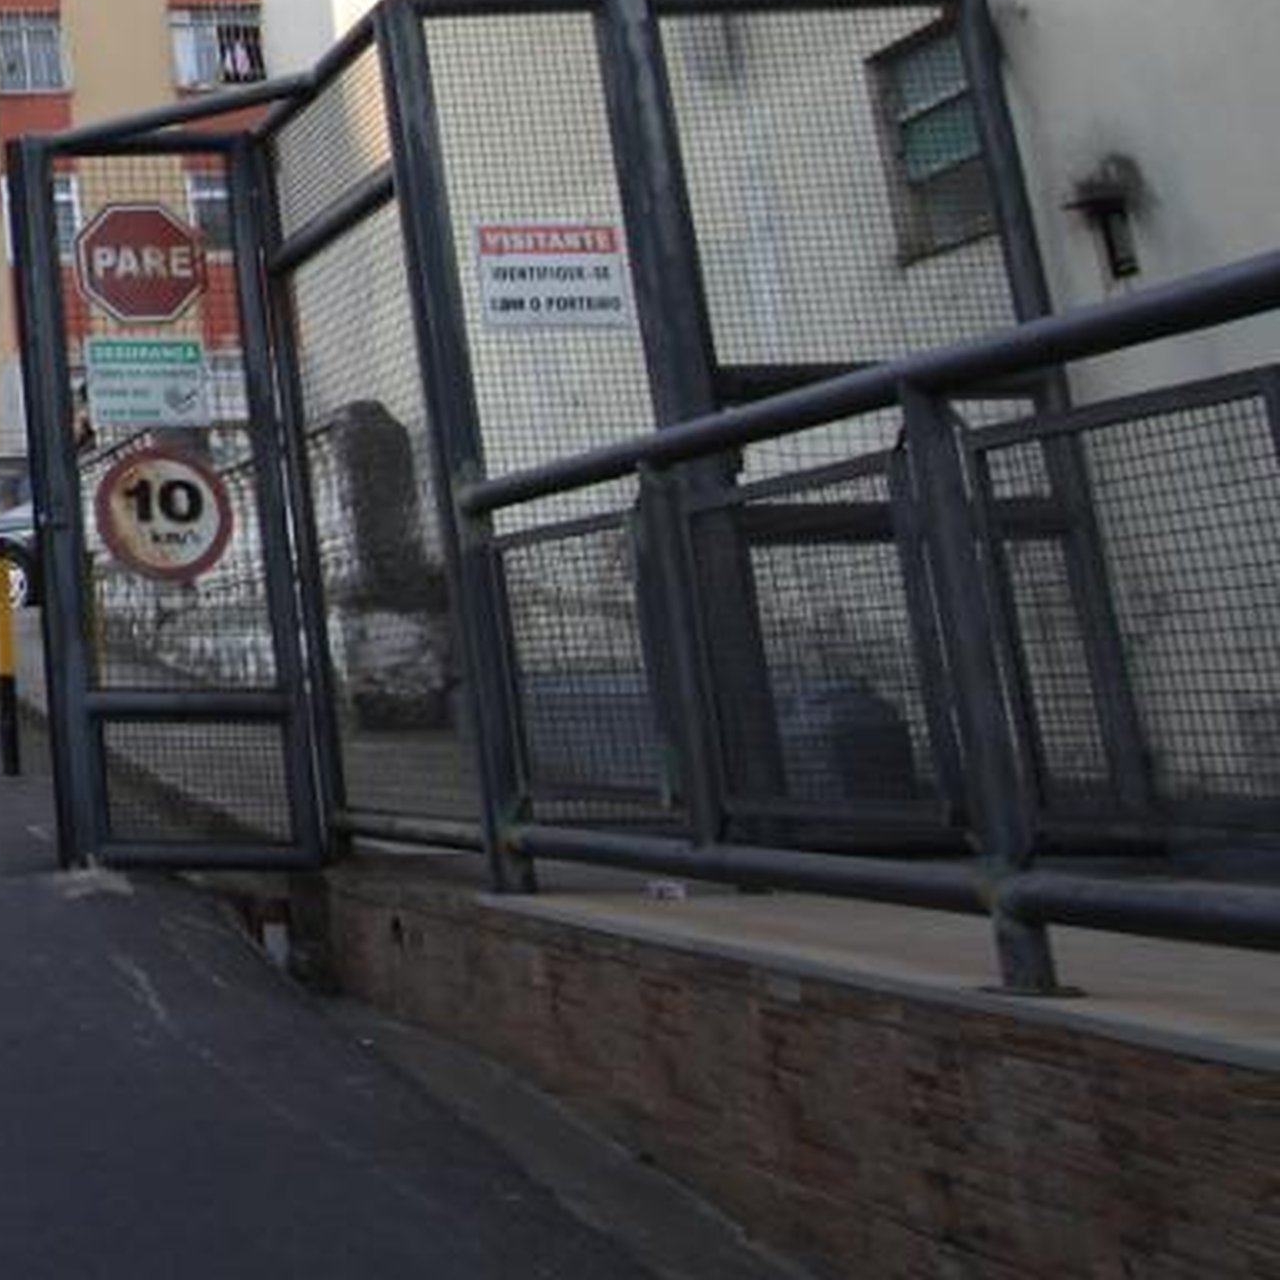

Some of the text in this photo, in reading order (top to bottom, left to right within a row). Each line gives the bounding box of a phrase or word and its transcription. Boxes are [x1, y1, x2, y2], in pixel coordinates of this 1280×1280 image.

[483, 230, 613, 250] VISITANTE
[93, 245, 193, 278] PARE
[530, 297, 541, 311] O
[123, 480, 203, 523] 10
